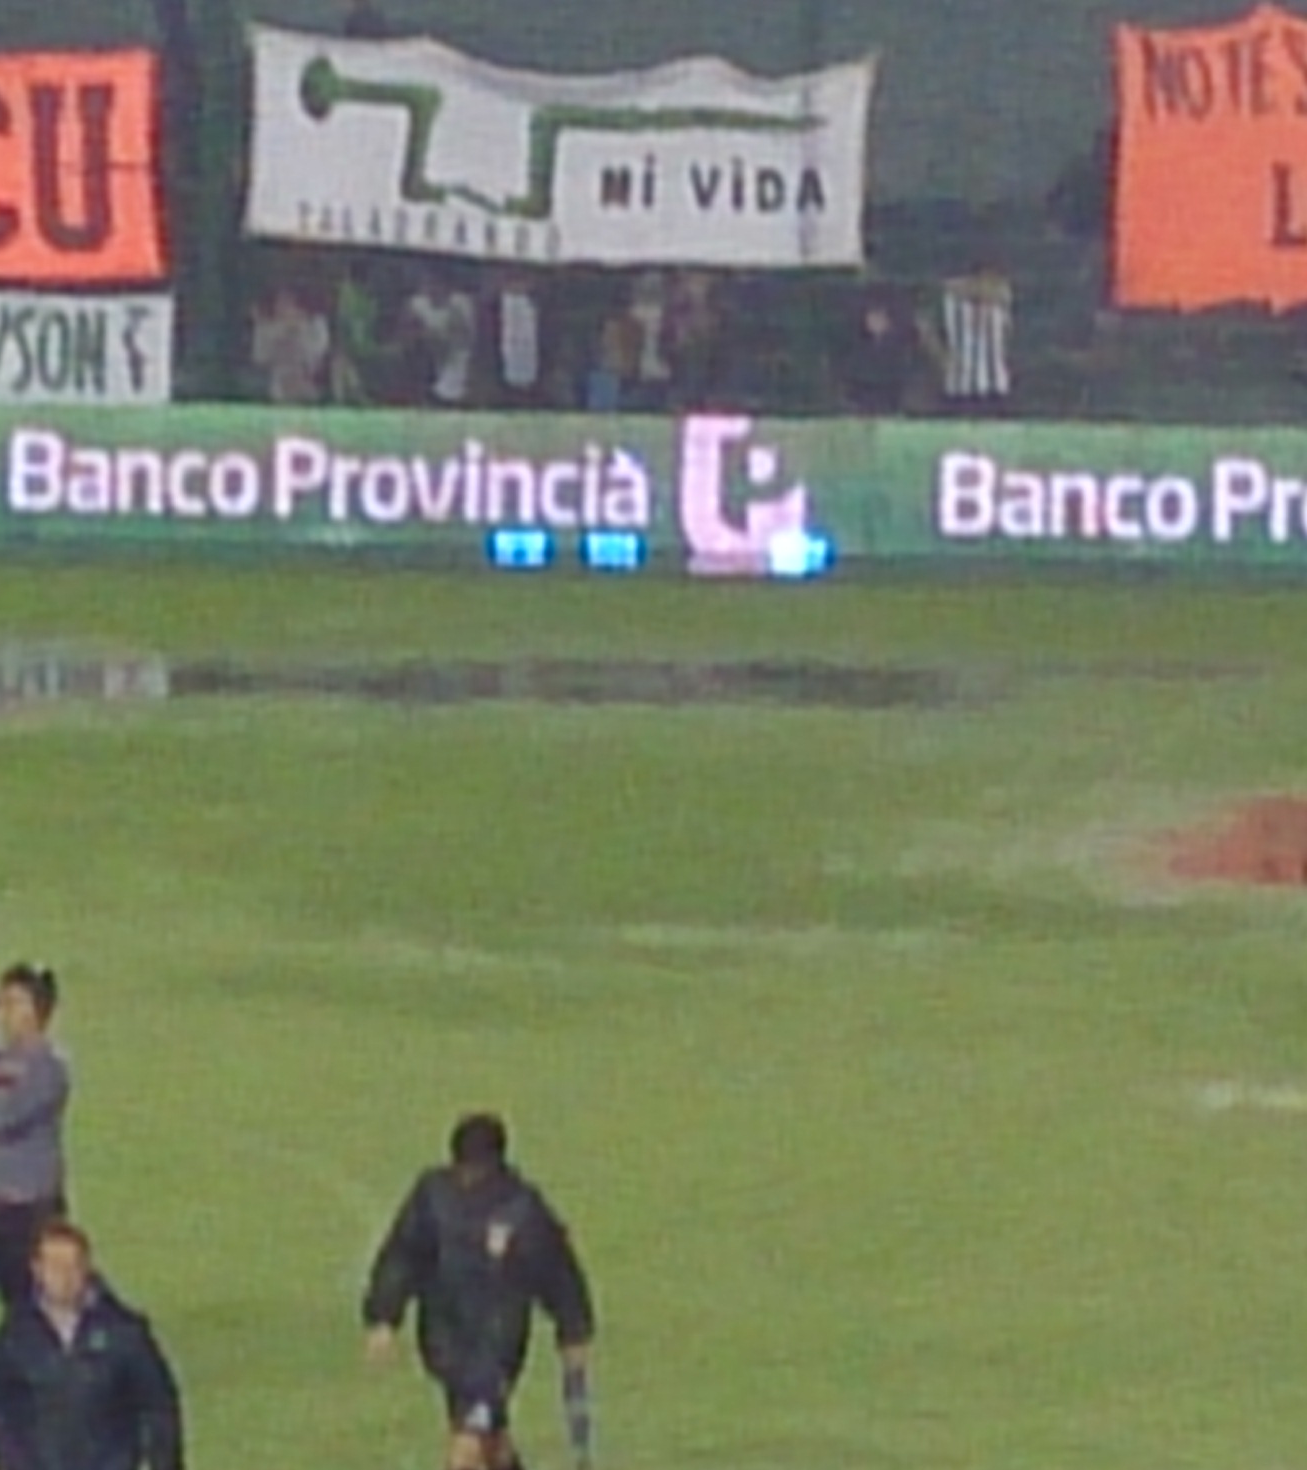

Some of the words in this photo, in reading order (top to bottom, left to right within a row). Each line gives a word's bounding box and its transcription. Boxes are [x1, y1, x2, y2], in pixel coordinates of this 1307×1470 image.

[8, 430, 260, 518] Banco
[273, 437, 649, 527] Provincia
[937, 450, 1199, 540] Banco
[1212, 458, 1307, 545] Pr
